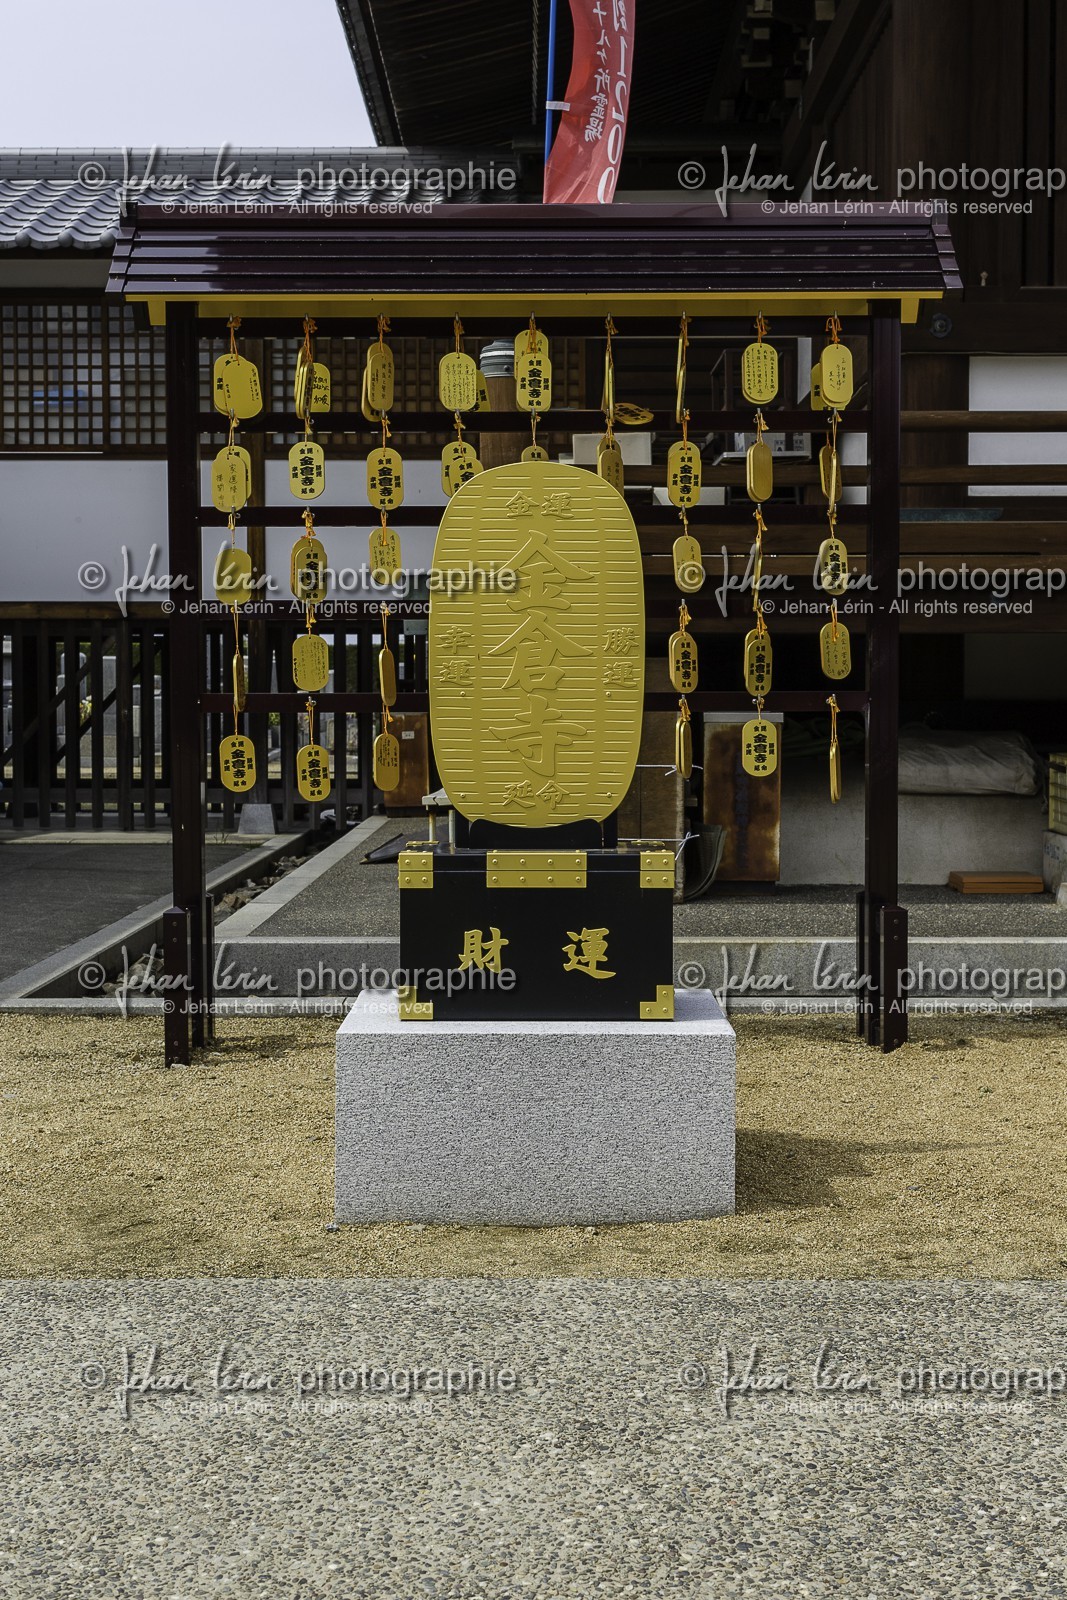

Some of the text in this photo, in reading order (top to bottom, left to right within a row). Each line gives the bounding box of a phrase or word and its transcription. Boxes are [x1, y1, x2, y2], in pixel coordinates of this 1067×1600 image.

[504, 490, 576, 519] 金運
[438, 625, 474, 687] 幸運
[487, 529, 595, 777] 金倉寺
